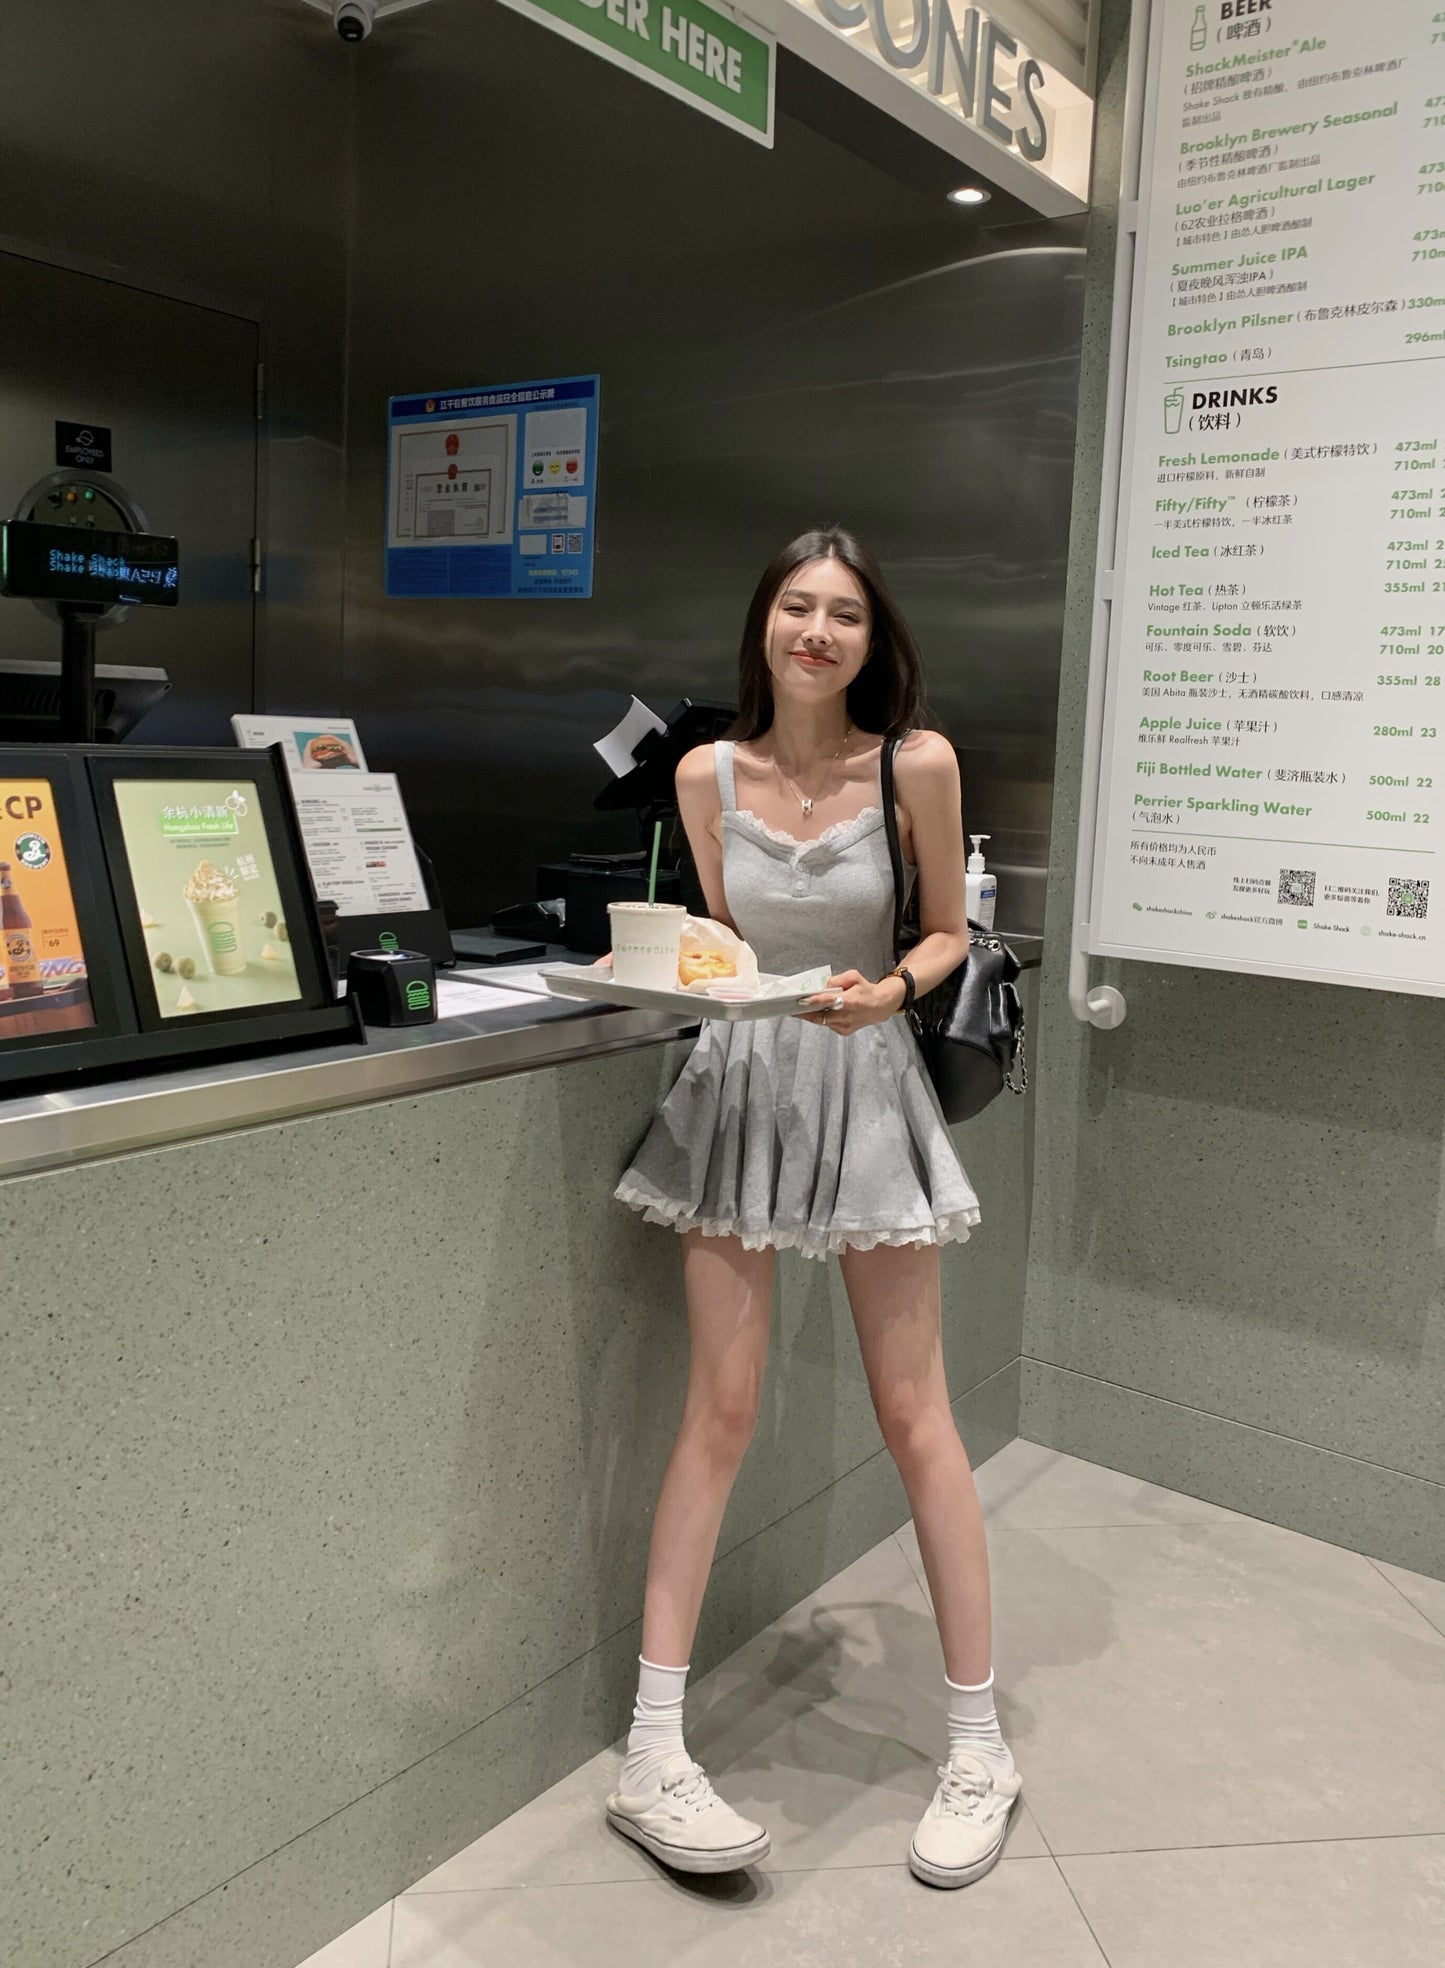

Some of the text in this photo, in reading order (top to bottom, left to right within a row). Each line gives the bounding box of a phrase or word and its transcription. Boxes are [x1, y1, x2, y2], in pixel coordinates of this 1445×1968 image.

[1220, 0, 1272, 20] BEER
[1217, 16, 1271, 43] （啤酒）
[662, 5, 742, 94] HERE
[815, 0, 1048, 163] ONES
[1180, 101, 1398, 155] Brooklyn Brewery Seasonal
[1228, 178, 1322, 208] Agricultural
[1327, 174, 1376, 191] Lager
[1171, 246, 1308, 276] Summer Juice IPA
[1167, 299, 1406, 337] Brooklyn Pilsner （布鲁克林皮尔森）
[1165, 347, 1272, 369] Tsingtao （青岛）
[1192, 386, 1278, 410] DRINKS
[1188, 412, 1241, 431] （饮料）
[1395, 439, 1437, 452] 473ml
[1158, 443, 1378, 467] Fresh Lemonade （美式柠檬特饮）
[1394, 458, 1436, 471] 710ml
[1245, 494, 1298, 508] （柠檬茶）
[1391, 488, 1433, 501] 473ml
[1390, 507, 1431, 519] 710ml
[1151, 544, 1265, 559] Iced Tea （冰红茶）
[1387, 540, 1429, 551] 473ml
[49, 549, 85, 562] Shake
[49, 561, 84, 573] Shake
[1386, 558, 1427, 570] 710ml
[1149, 583, 1247, 597] Hot Tea （热茶）
[1384, 581, 1425, 593] 355ml
[1147, 602, 1180, 613] Vintage
[1211, 602, 1238, 612] Lipton
[1146, 623, 1296, 638] Fountain Soda （软饮）
[1380, 626, 1445, 637] 473ml 17
[1379, 644, 1444, 655] 710ml 20
[1143, 670, 1257, 684] Root Beer （沙士）
[1377, 675, 1441, 686] 355ml 28
[1142, 687, 1160, 697] 美国
[1162, 687, 1186, 697] Abita
[1140, 717, 1278, 733] Apple Juice （苹果汁）
[1373, 726, 1437, 738] 280ml 23
[1169, 735, 1208, 745] Realfresh
[1211, 736, 1240, 747] 苹果汁
[1136, 761, 1347, 784] Fiji Bottled Water （斐济瓶装水）
[1369, 775, 1433, 788] 500ml 22
[0, 795, 42, 820] CP
[1134, 794, 1313, 817] Perrier Sparkling Water
[1132, 811, 1180, 825] （气泡水）
[1366, 810, 1430, 823] 500ml 22
[1130, 840, 1217, 856] 所有价格均为人民币
[1130, 855, 1206, 870] 不向未成年人售酒
[1313, 922, 1350, 933] Shake Shack
